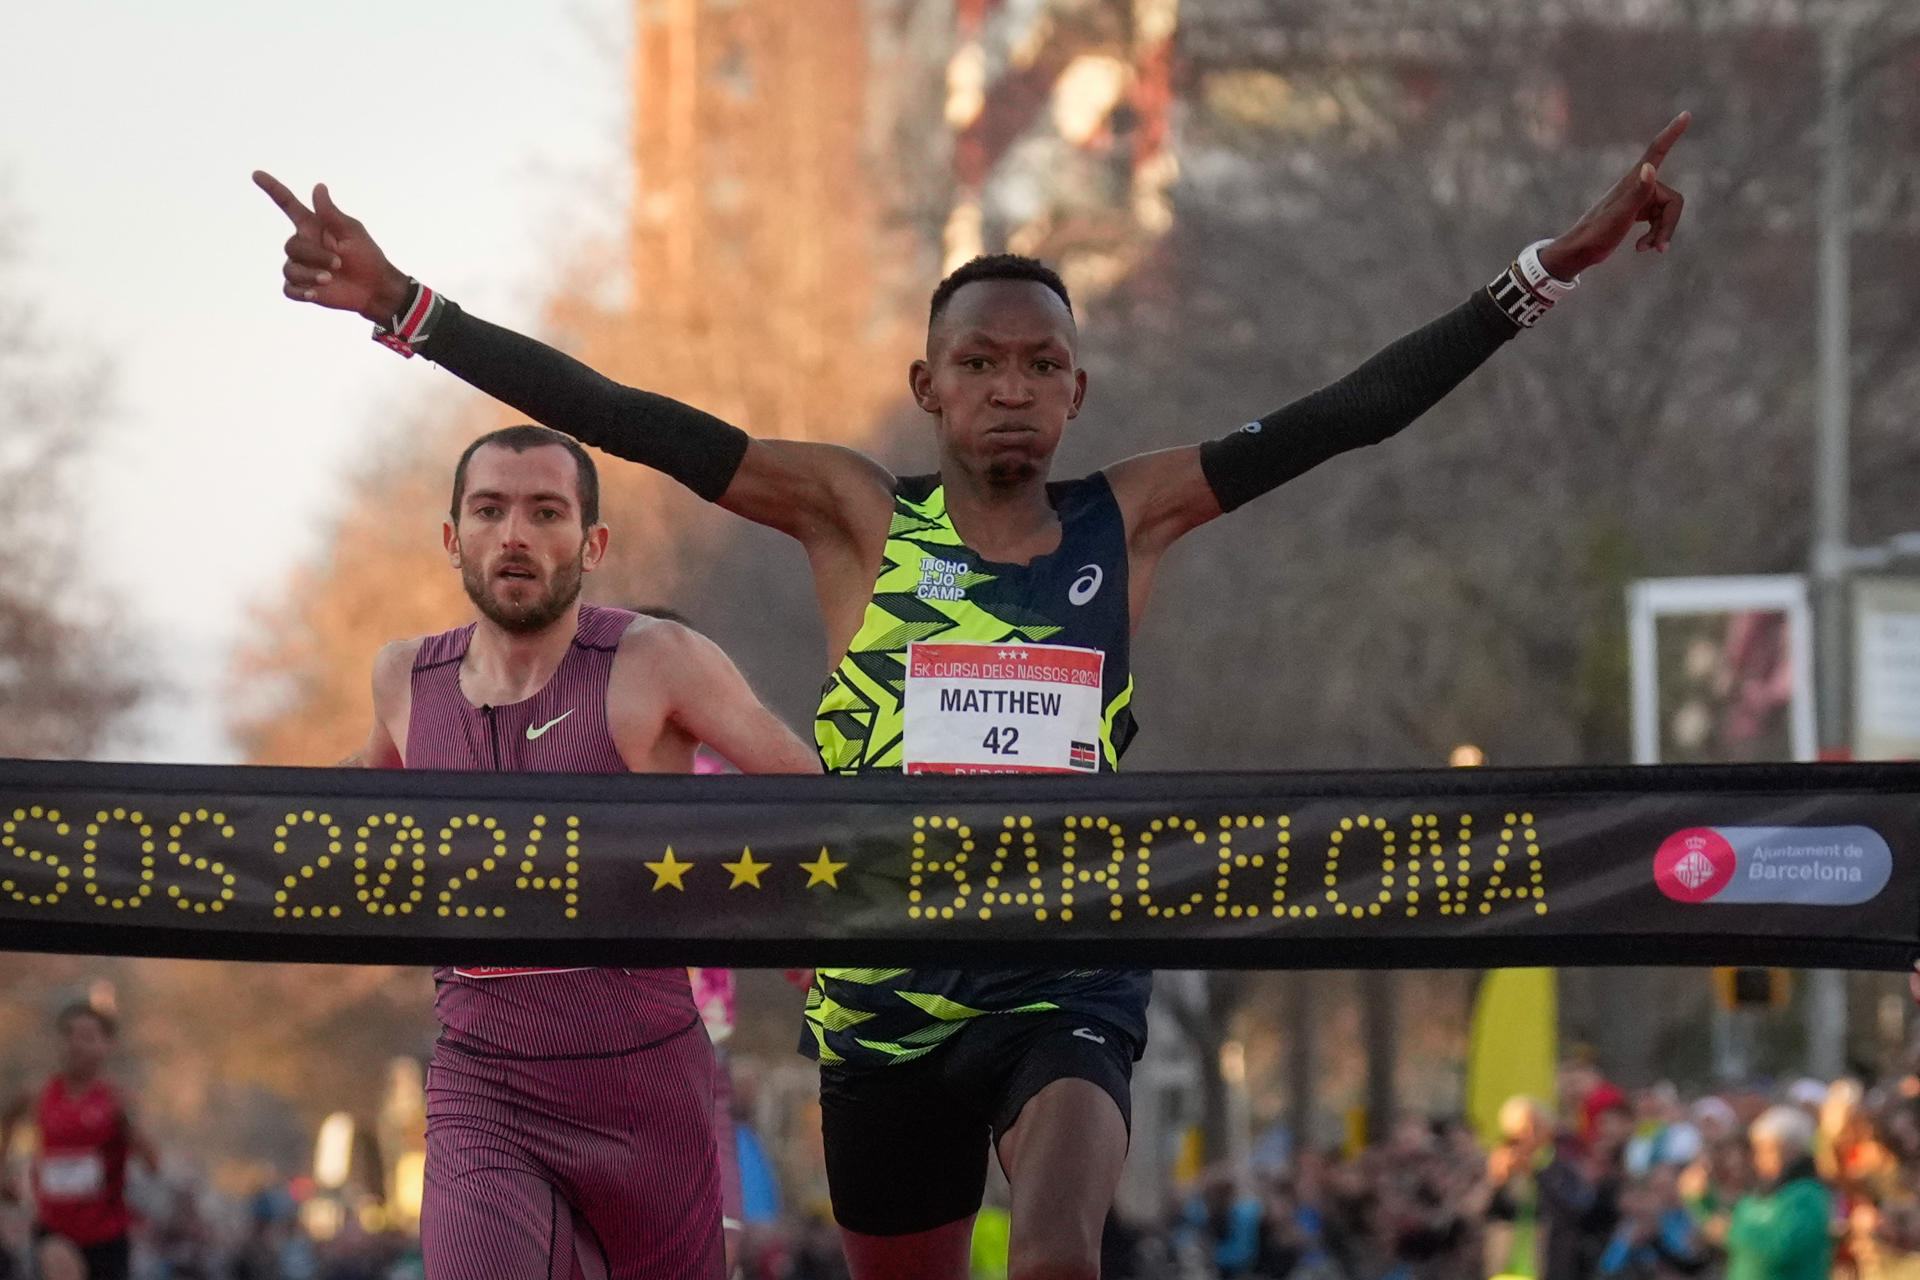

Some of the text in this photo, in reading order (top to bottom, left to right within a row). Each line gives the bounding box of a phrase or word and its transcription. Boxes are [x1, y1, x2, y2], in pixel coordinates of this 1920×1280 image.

[917, 584, 966, 601] CAMP
[914, 663, 1099, 687] 5K CURSA DELS NASSOS 2024
[940, 688, 1062, 716] MATTHEW
[982, 726, 1020, 755] 42
[1, 805, 1548, 922] SOS 2024 BARCELONA
[1752, 843, 1864, 862] Ajuntament de
[1748, 860, 1863, 883] Barcelona
